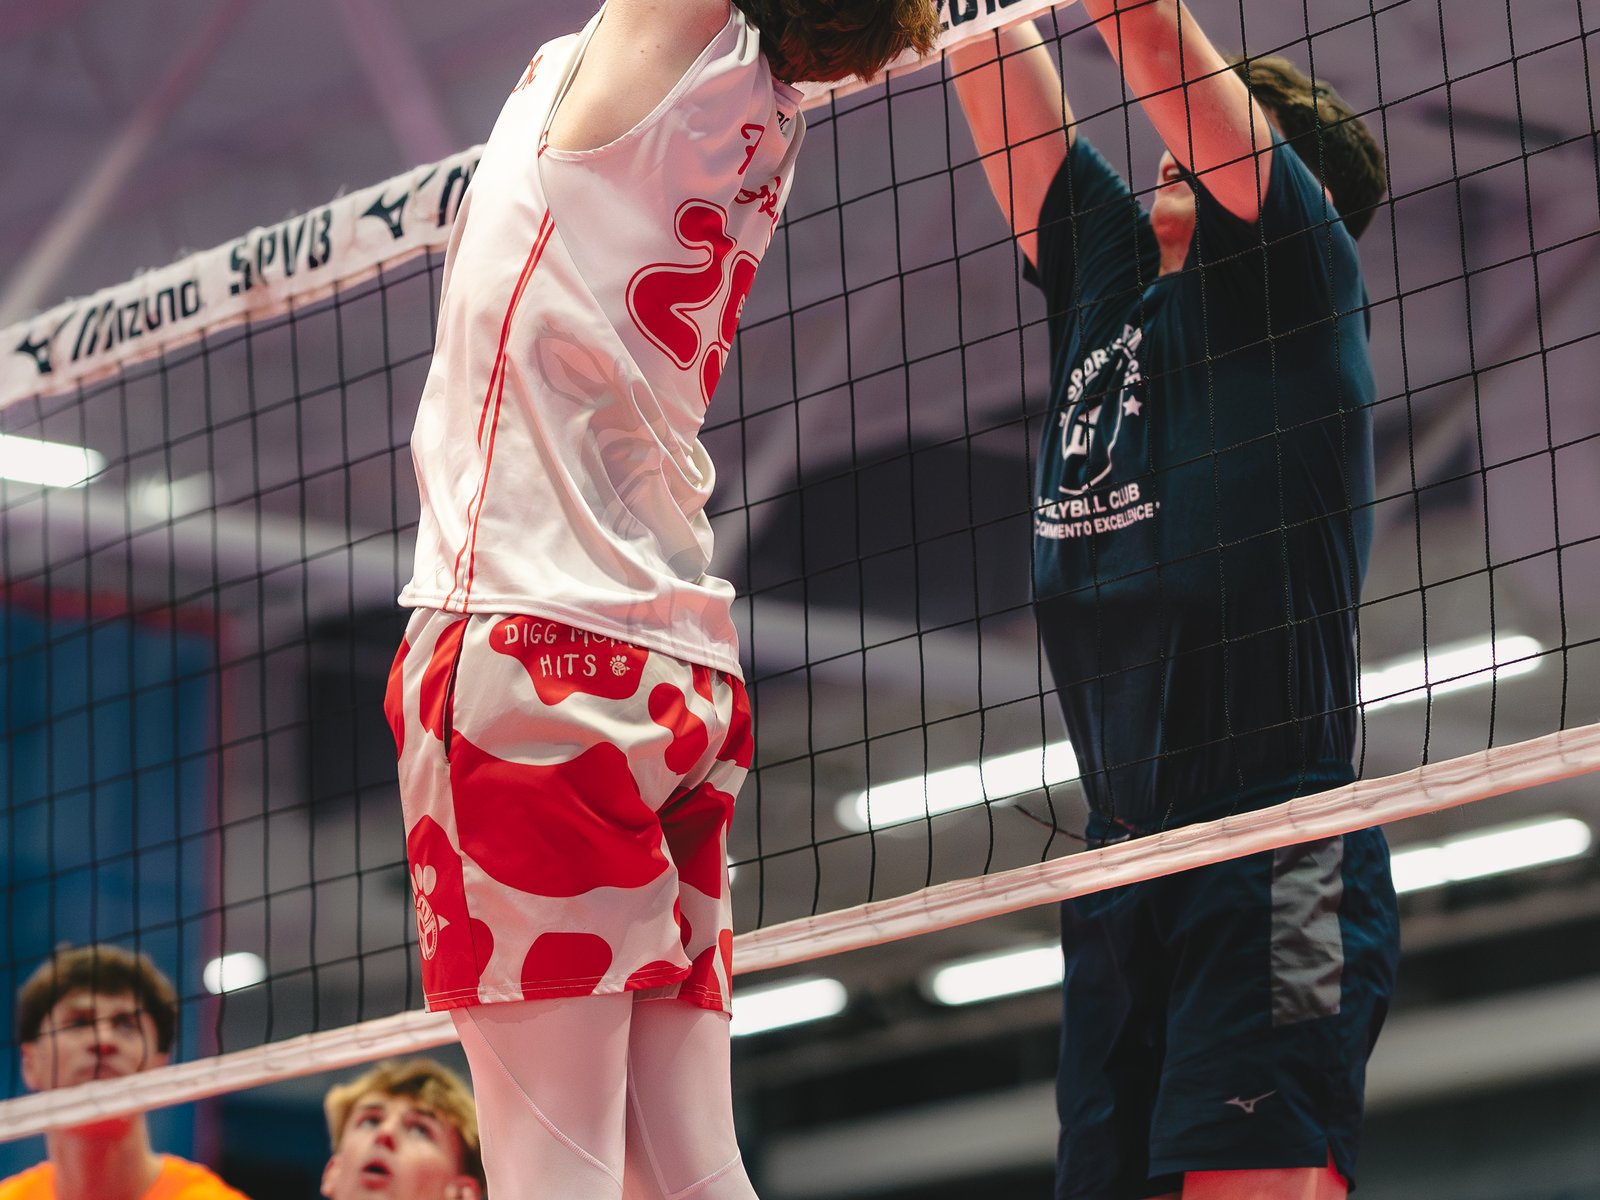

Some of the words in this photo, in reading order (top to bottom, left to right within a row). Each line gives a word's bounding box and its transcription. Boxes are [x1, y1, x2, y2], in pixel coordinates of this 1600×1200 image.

[230, 209, 332, 295] SPVB
[1109, 482, 1140, 509] CLUB
[504, 623, 557, 647] DIGG
[540, 654, 597, 678] HITS
